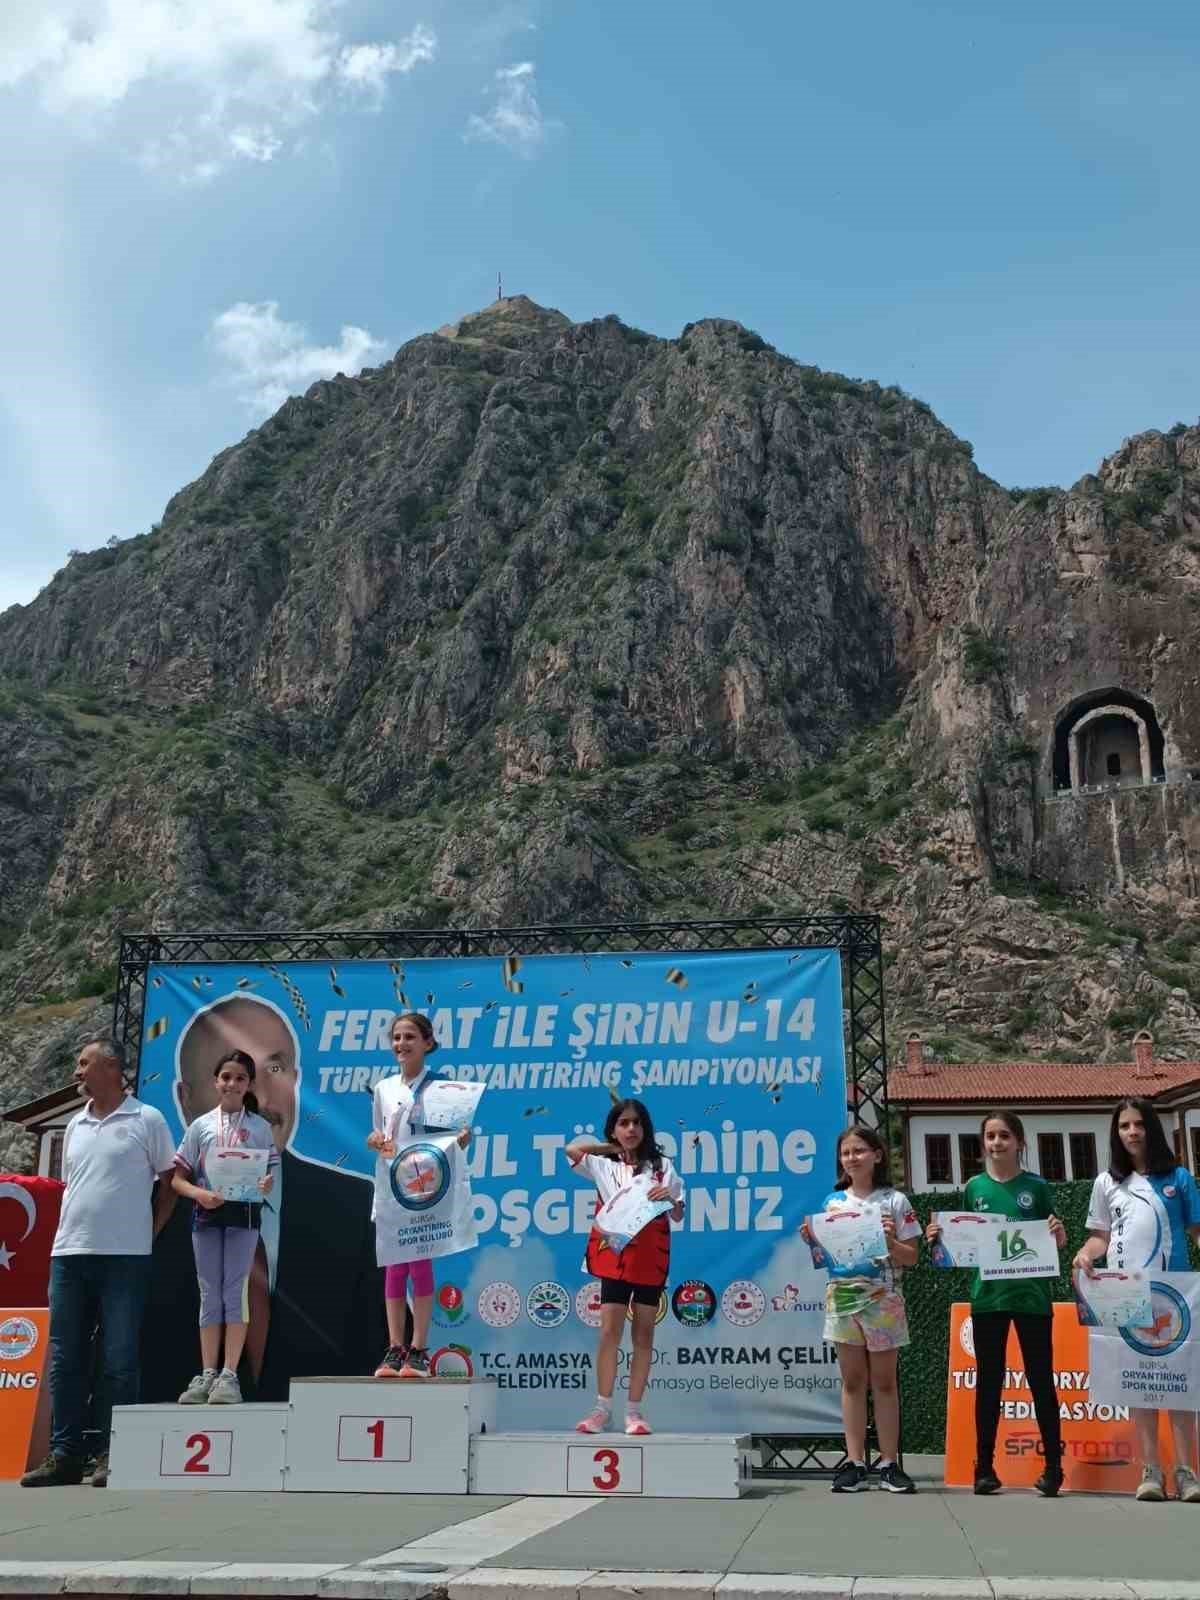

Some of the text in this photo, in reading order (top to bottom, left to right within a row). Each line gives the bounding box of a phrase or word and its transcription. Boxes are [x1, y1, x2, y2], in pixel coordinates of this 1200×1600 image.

[318, 1007, 484, 1052] FERAT
[568, 1001, 693, 1059] ŞİRİN
[706, 998, 816, 1044] U-14
[319, 1065, 432, 1094] TÜRK
[631, 1055, 822, 1095] ŞAMPİYONASI
[470, 1175, 784, 1248] OŞGENİZ
[997, 1229, 1028, 1260] 16
[793, 1301, 827, 1312] nurt
[480, 1352, 593, 1369] T.C. AMASYA
[677, 1346, 771, 1366] BAYRAM
[710, 1374, 779, 1394] Belediye
[1121, 1380, 1188, 1393] SPOR KULÜBÜ
[185, 1433, 210, 1473] 2
[366, 1420, 383, 1458] 1
[594, 1449, 620, 1490] 3
